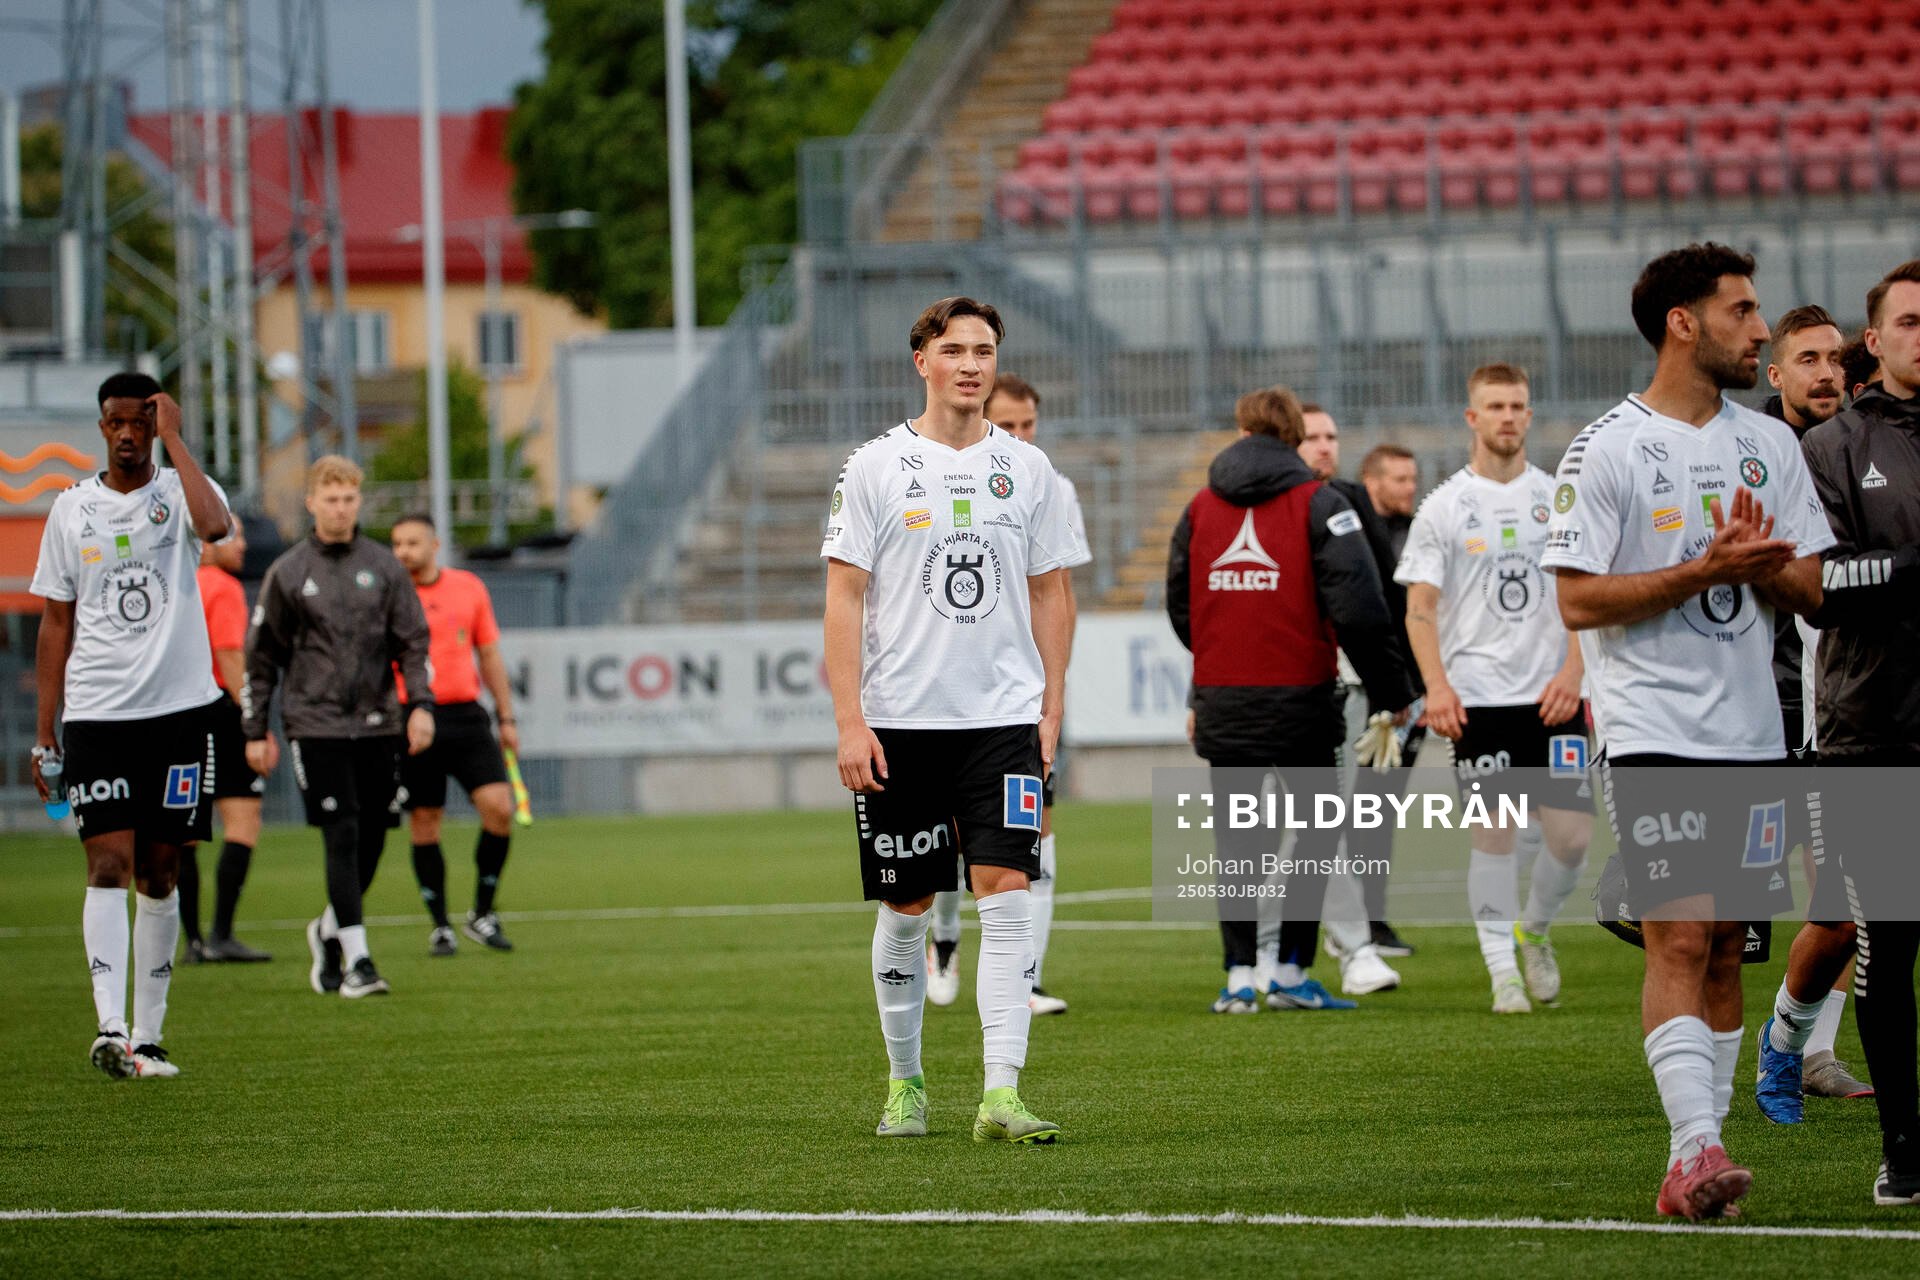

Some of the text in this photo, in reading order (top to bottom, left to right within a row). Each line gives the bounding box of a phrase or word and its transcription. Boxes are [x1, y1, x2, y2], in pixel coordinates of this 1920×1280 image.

[1861, 479, 1887, 489] SELECT
[905, 491, 926, 499] SELECT
[922, 530, 1001, 595] STOLTHET, HJÄRTA & PASSION
[1208, 570, 1280, 591] SELECT
[955, 615, 976, 624] 1908
[566, 654, 719, 700] ICON
[757, 650, 832, 698] IC
[880, 869, 897, 884] 18
[1647, 859, 1671, 881] 22
[1743, 941, 1762, 952] ECT
